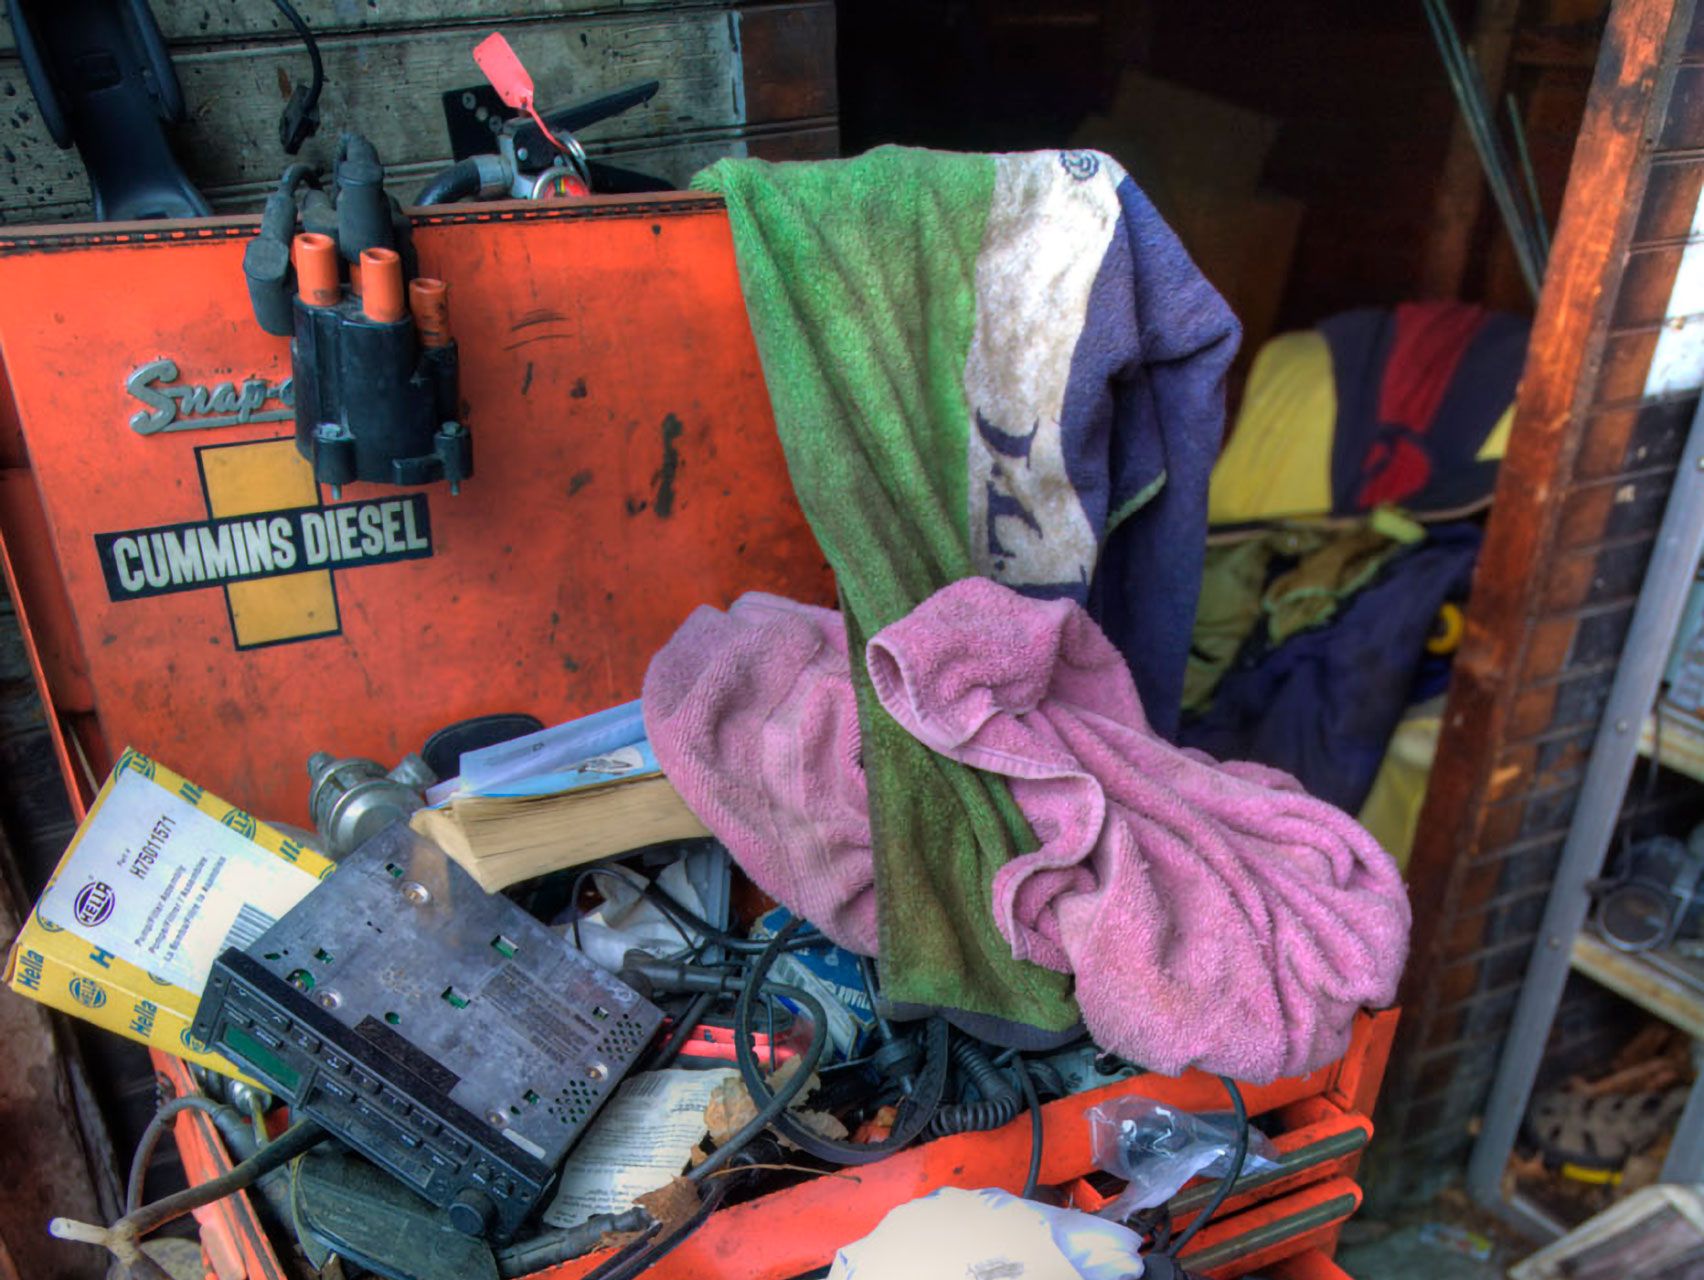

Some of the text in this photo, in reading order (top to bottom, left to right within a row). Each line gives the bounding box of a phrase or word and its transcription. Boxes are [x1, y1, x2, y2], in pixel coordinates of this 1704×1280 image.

[113, 500, 428, 592] CUMMINS DIESEL
[129, 815, 177, 880] H75011571
[80, 881, 111, 924] HELLA
[17, 949, 45, 991] Hella
[129, 1000, 158, 1038] Hella
